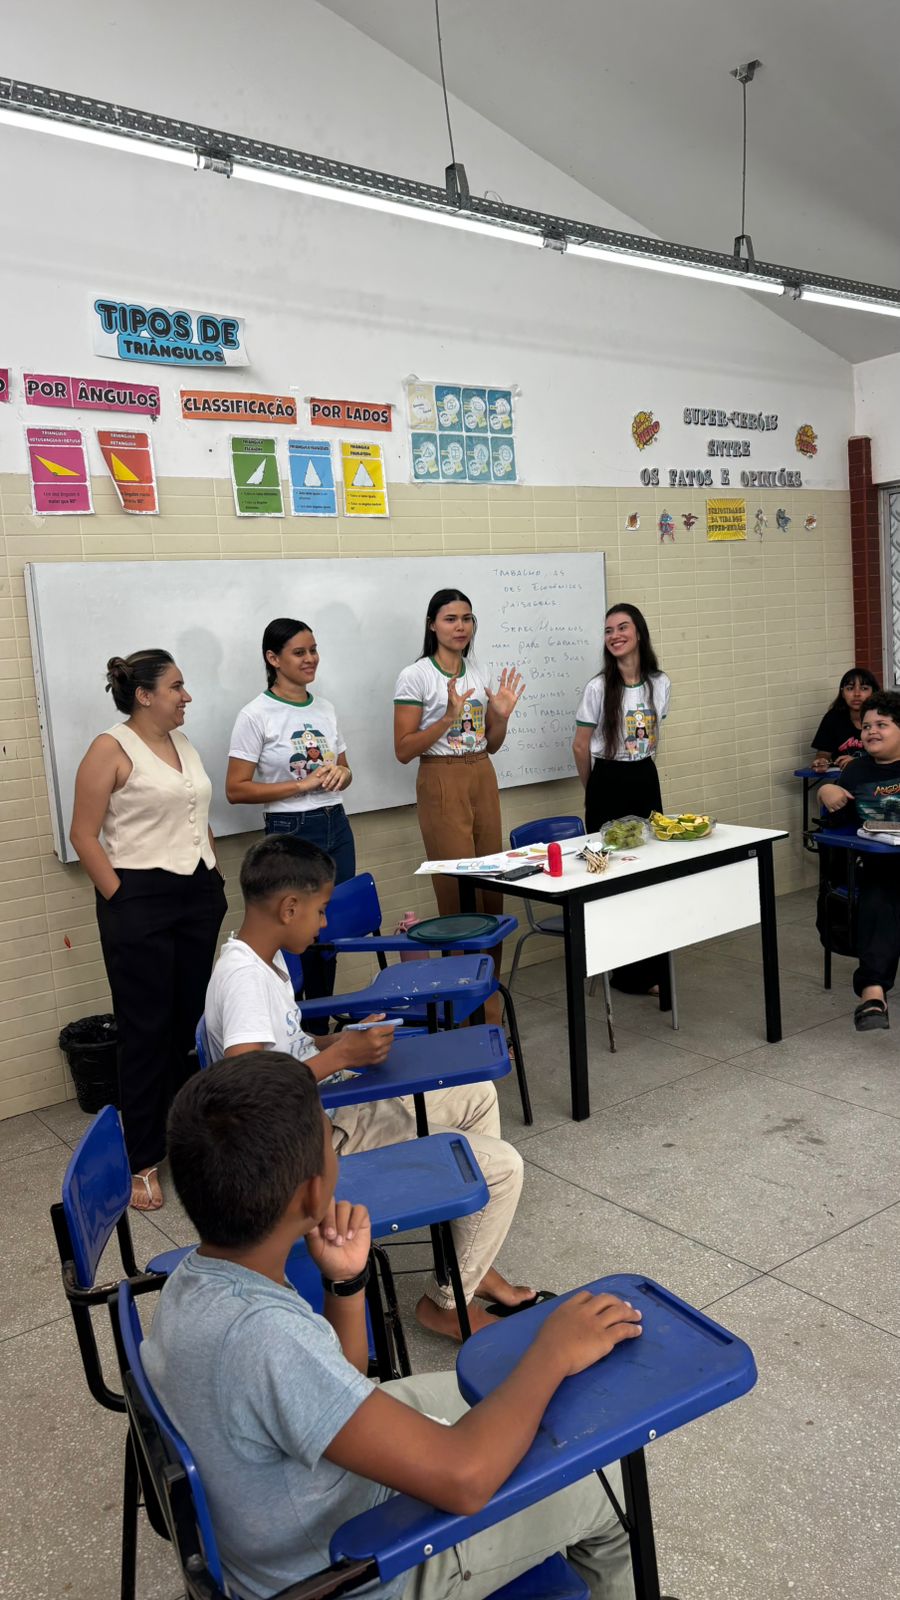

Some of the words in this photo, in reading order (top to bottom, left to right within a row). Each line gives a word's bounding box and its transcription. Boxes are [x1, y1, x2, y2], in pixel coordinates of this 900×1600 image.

[96, 301, 192, 344] TIPOS
[198, 317, 240, 348] DE
[123, 340, 225, 363] TRIÂNGULOS
[27, 380, 67, 398] POR
[78, 382, 158, 408] ÂNGULOS
[183, 397, 295, 420] CLASSIFICAÇÃO
[312, 403, 341, 419] POR
[346, 407, 389, 424] LADOS
[639, 421, 661, 443] HERO
[707, 440, 750, 457] ENTRE
[640, 468, 660, 486] OS
[669, 469, 713, 487] FATOS
[720, 468, 730, 486] E
[740, 468, 802, 488] OPINIÕES
